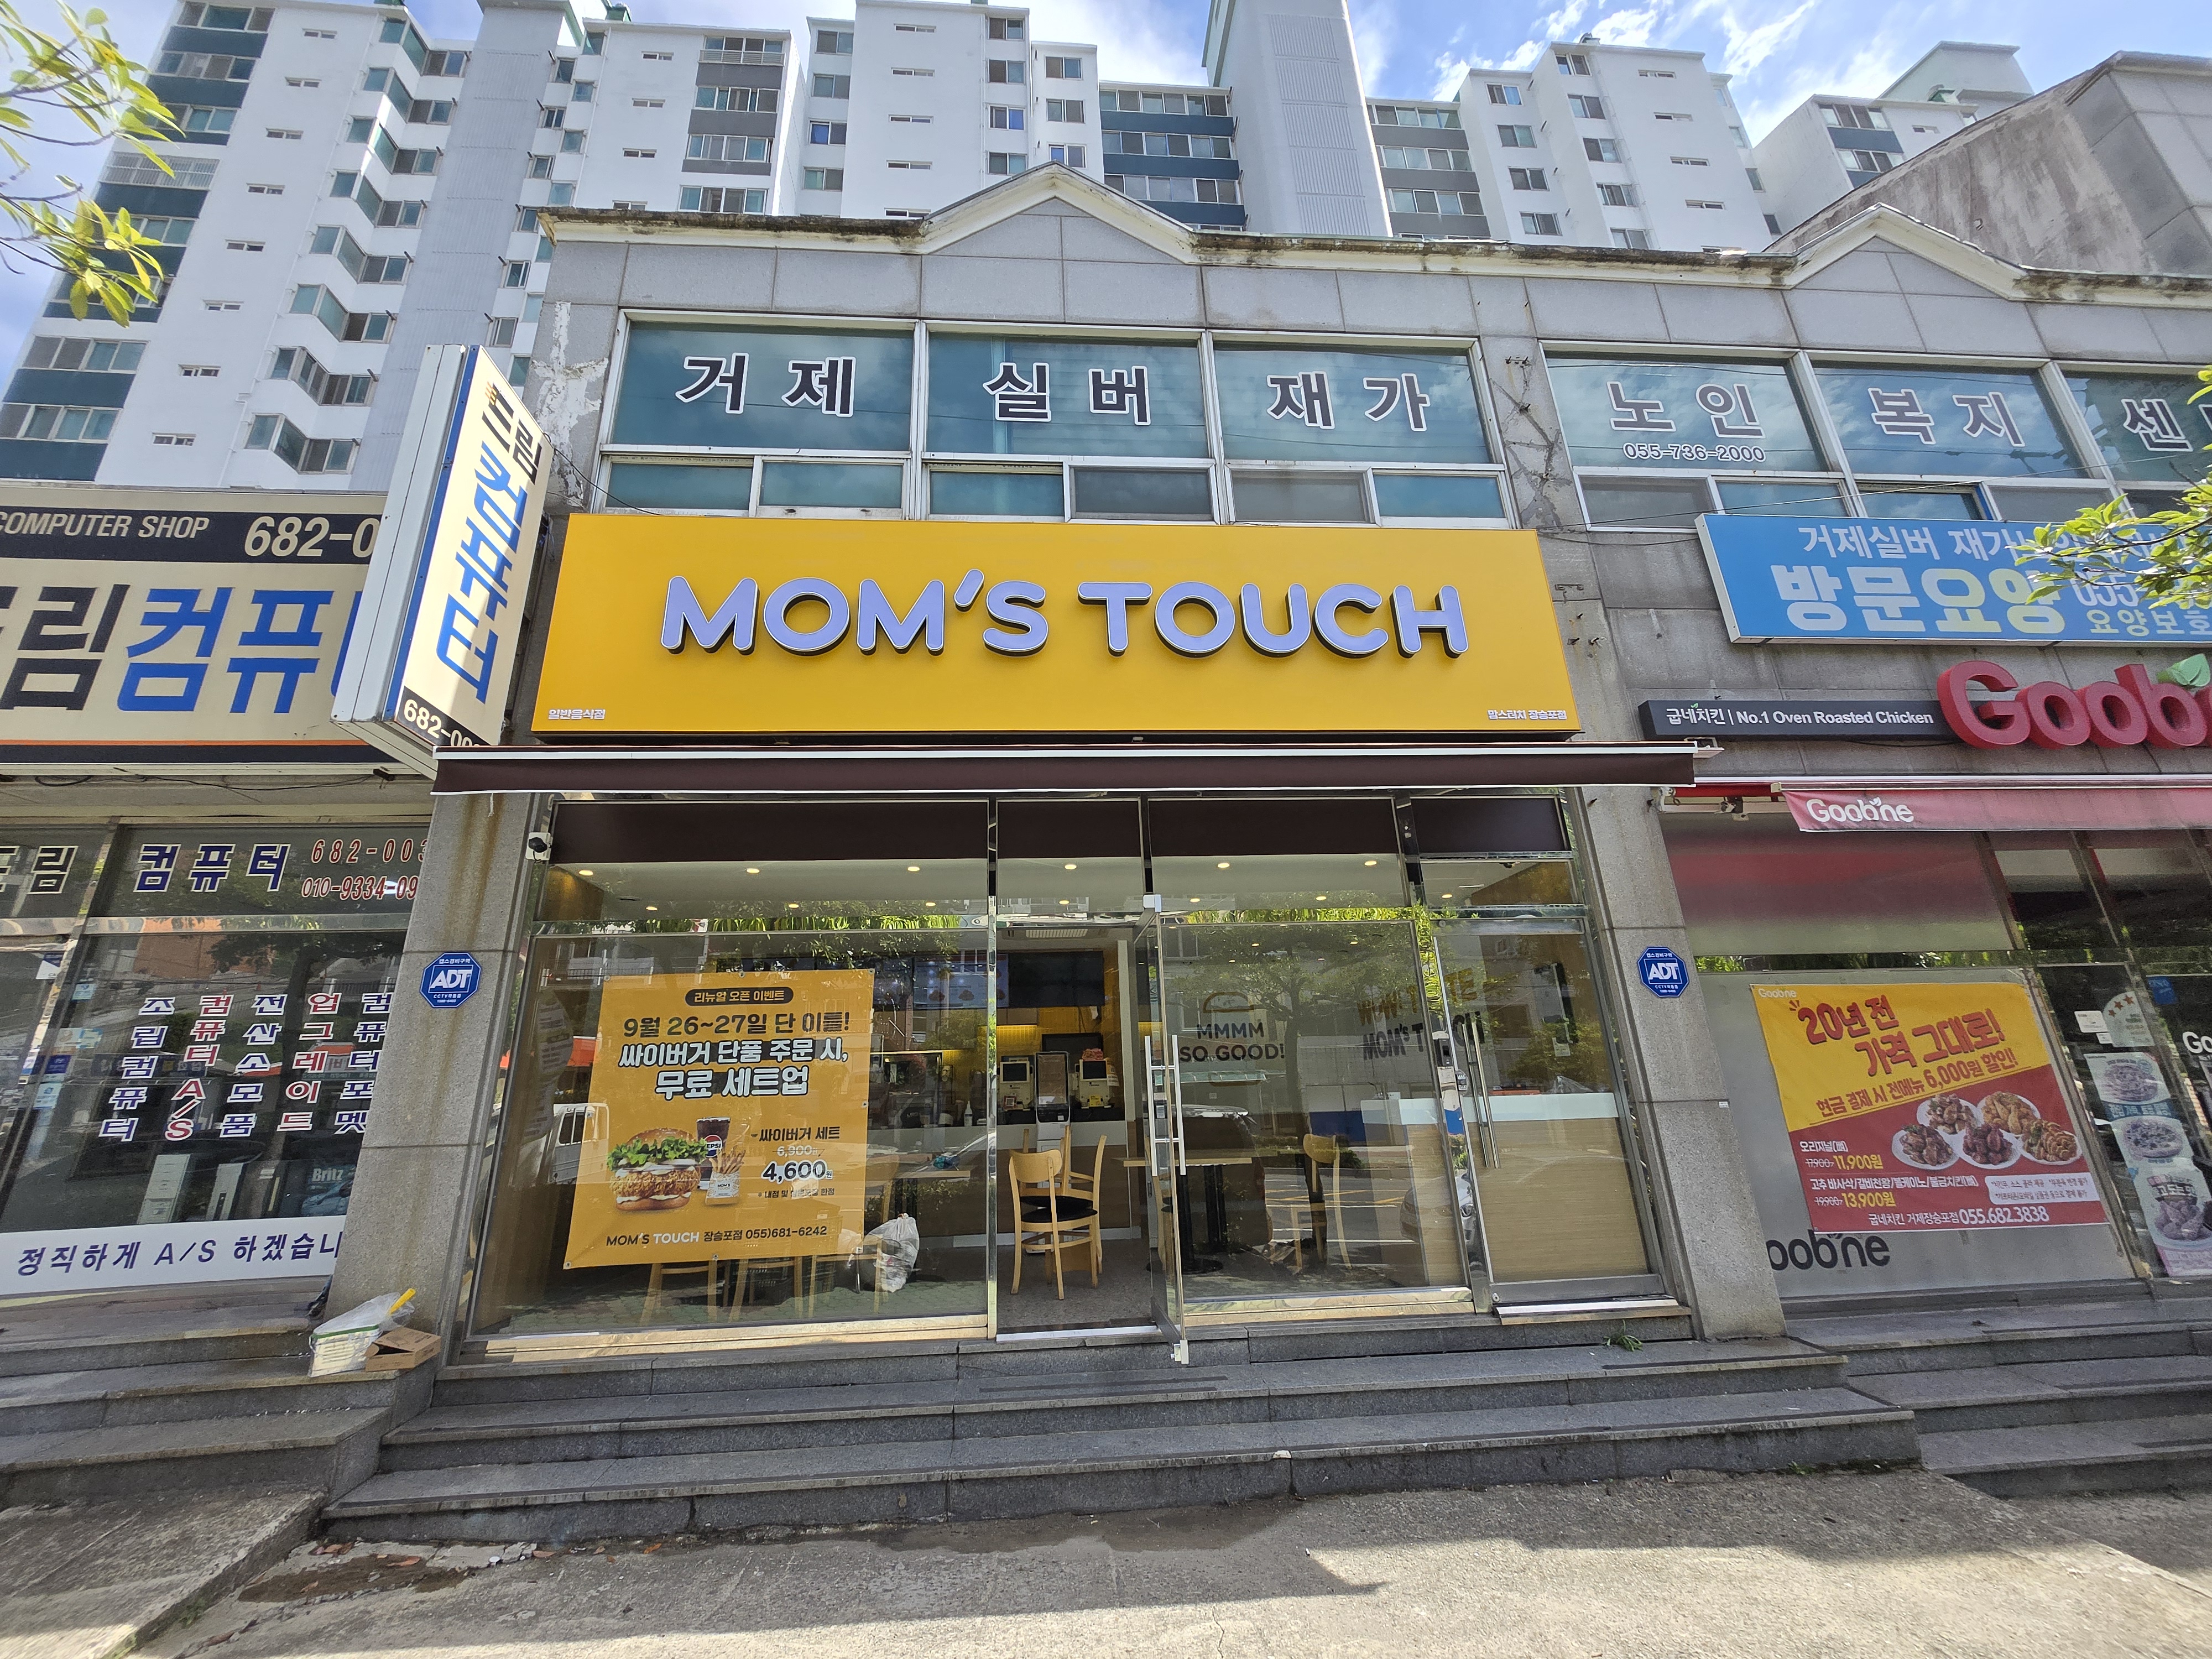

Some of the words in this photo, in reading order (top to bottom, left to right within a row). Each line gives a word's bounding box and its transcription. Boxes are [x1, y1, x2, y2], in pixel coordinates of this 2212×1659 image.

[1623, 442, 1766, 462] 055-736-2000
[138, 516, 210, 538] SHOP
[1797, 525, 1941, 560] 거제실버
[1770, 565, 2065, 634] 방문요양
[660, 567, 1049, 657] MOM'S
[1078, 581, 1472, 659] TOUCH
[548, 709, 606, 720] 일반음식점
[1488, 709, 1527, 719] 맘스터치
[1528, 709, 1567, 719] 장승포점
[1937, 660, 2212, 750] Goob
[1666, 708, 1725, 726] 굽네치킨
[1736, 711, 1769, 724] No.1
[1772, 711, 1812, 724] Oven
[1814, 711, 1874, 724] Roasted
[1878, 711, 1934, 724] Chicken
[134, 843, 291, 893] 컴퓨터
[429, 969, 473, 989] ADT
[1648, 962, 1678, 980] ADT
[694, 991, 726, 1003] 리뉴얼
[729, 990, 750, 1001] 오픈
[753, 989, 785, 1001] 이벤트
[624, 1017, 660, 1038] 9월
[667, 1013, 768, 1036] 26~27일
[775, 1013, 796, 1034] 단
[802, 1011, 850, 1032] 이틀!
[1798, 1001, 1871, 1045] 20년
[1865, 994, 1899, 1030] 전
[1197, 1022, 1264, 1040] MMMM
[618, 1041, 711, 1067] 싸이버거
[718, 1040, 762, 1064] 단품
[769, 1038, 813, 1062] 주문
[820, 1037, 848, 1062] 시,
[1180, 1045, 1208, 1062] SO
[1215, 1043, 1285, 1061] GOOD!
[1854, 1030, 1917, 1077] 가격
[1912, 1008, 2006, 1063] 그대로!
[655, 1069, 713, 1100] 무료
[722, 1065, 809, 1097] 세트업
[1816, 1096, 1848, 1117] 현금
[1846, 1088, 1873, 1110] 결제
[1875, 1084, 1888, 1103] 시
[1888, 1077, 1926, 1100] 전메뉴
[1923, 1058, 1985, 1089] 6,000원
[1980, 1047, 2019, 1073] 할인!
[759, 1127, 811, 1141] 싸이버거
[815, 1126, 840, 1140] 세트
[1833, 1155, 1884, 1170] 11,900원
[312, 1168, 343, 1182] Britz
[1810, 1178, 1827, 1190] 고추
[765, 1190, 779, 1198] 내점
[1841, 1192, 1896, 1208] 13,900원
[1869, 1213, 1905, 1226] 굽네치킨
[1906, 1212, 1959, 1225] 거제장승포점
[1959, 1206, 2049, 1225] 055.682.3838
[607, 1233, 650, 1246] MOM'S
[653, 1232, 700, 1244] TOUCH
[703, 1230, 743, 1242] 장승포점
[745, 1225, 827, 1239] 055)681-6242
[17, 1241, 142, 1276] 정직하게
[154, 1239, 216, 1266] A/S
